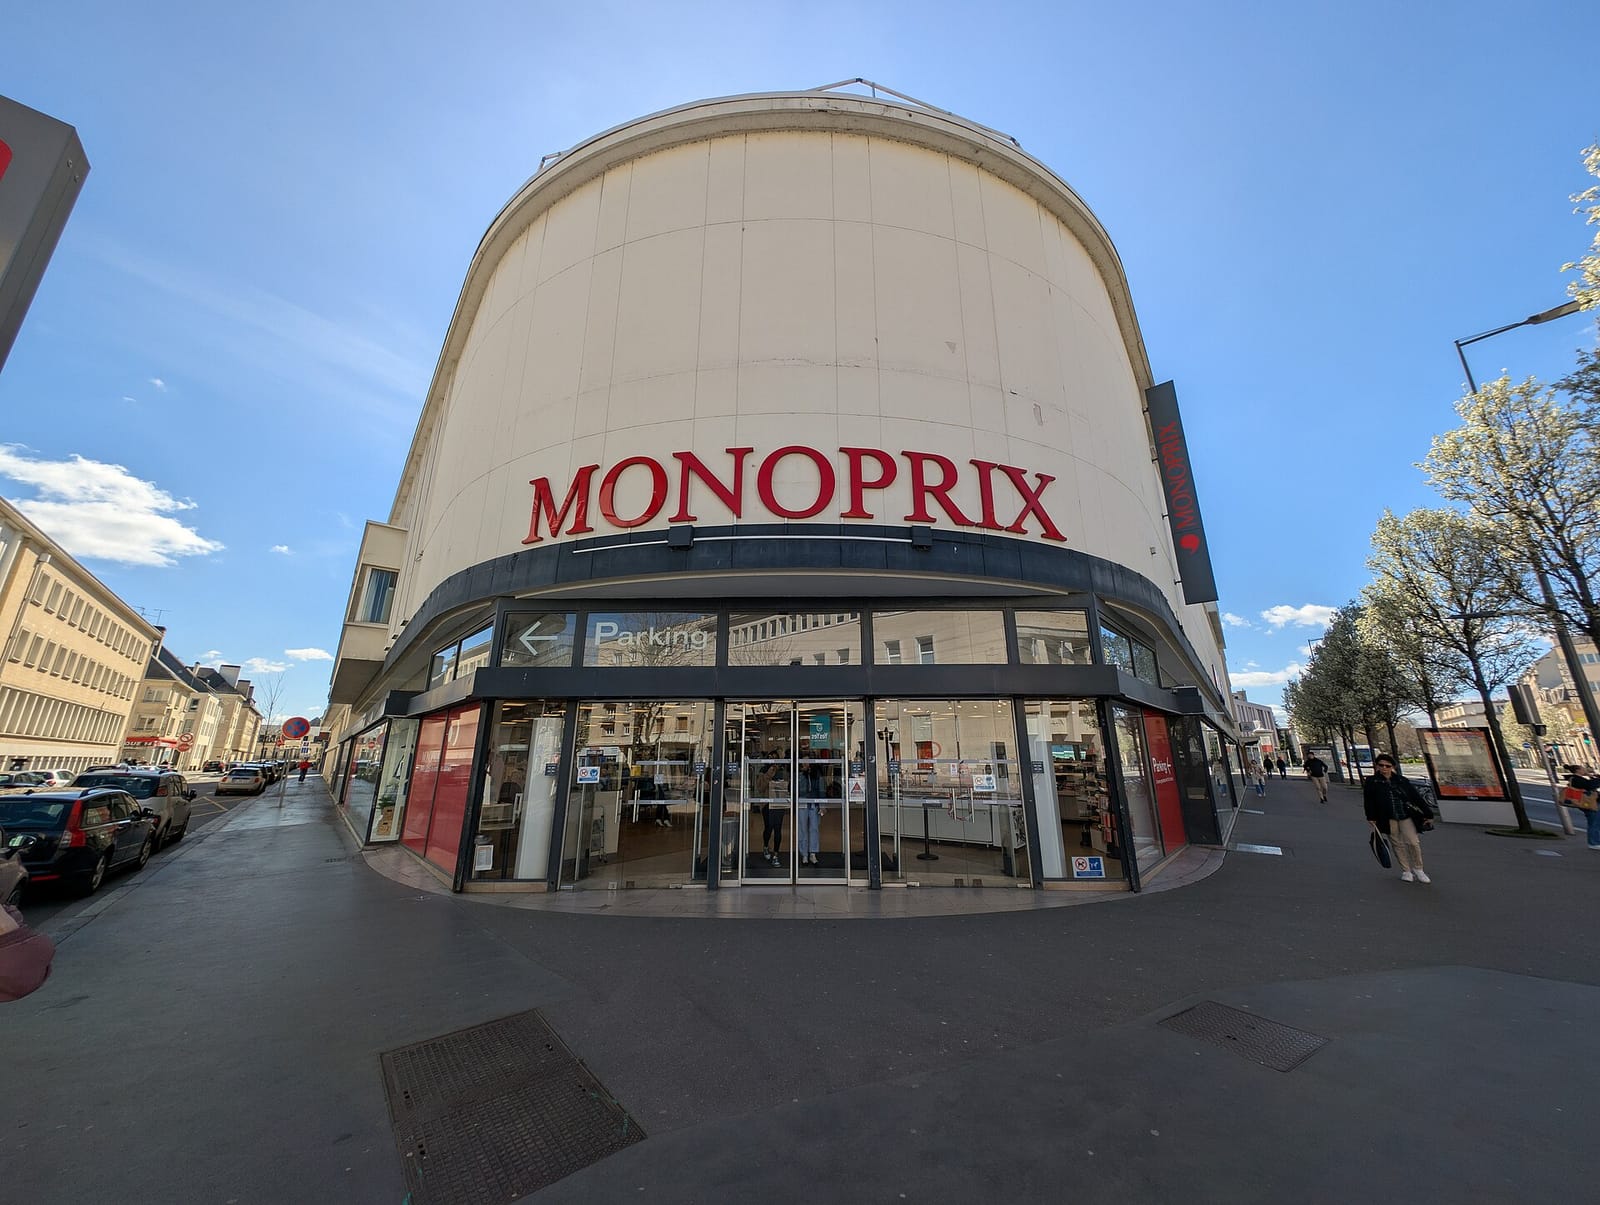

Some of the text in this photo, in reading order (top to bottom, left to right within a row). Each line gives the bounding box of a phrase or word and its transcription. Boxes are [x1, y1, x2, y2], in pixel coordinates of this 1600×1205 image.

[522, 446, 1066, 542] MONOPRIX
[1159, 421, 1196, 529] MONOPRIX
[595, 622, 708, 650] Parking
